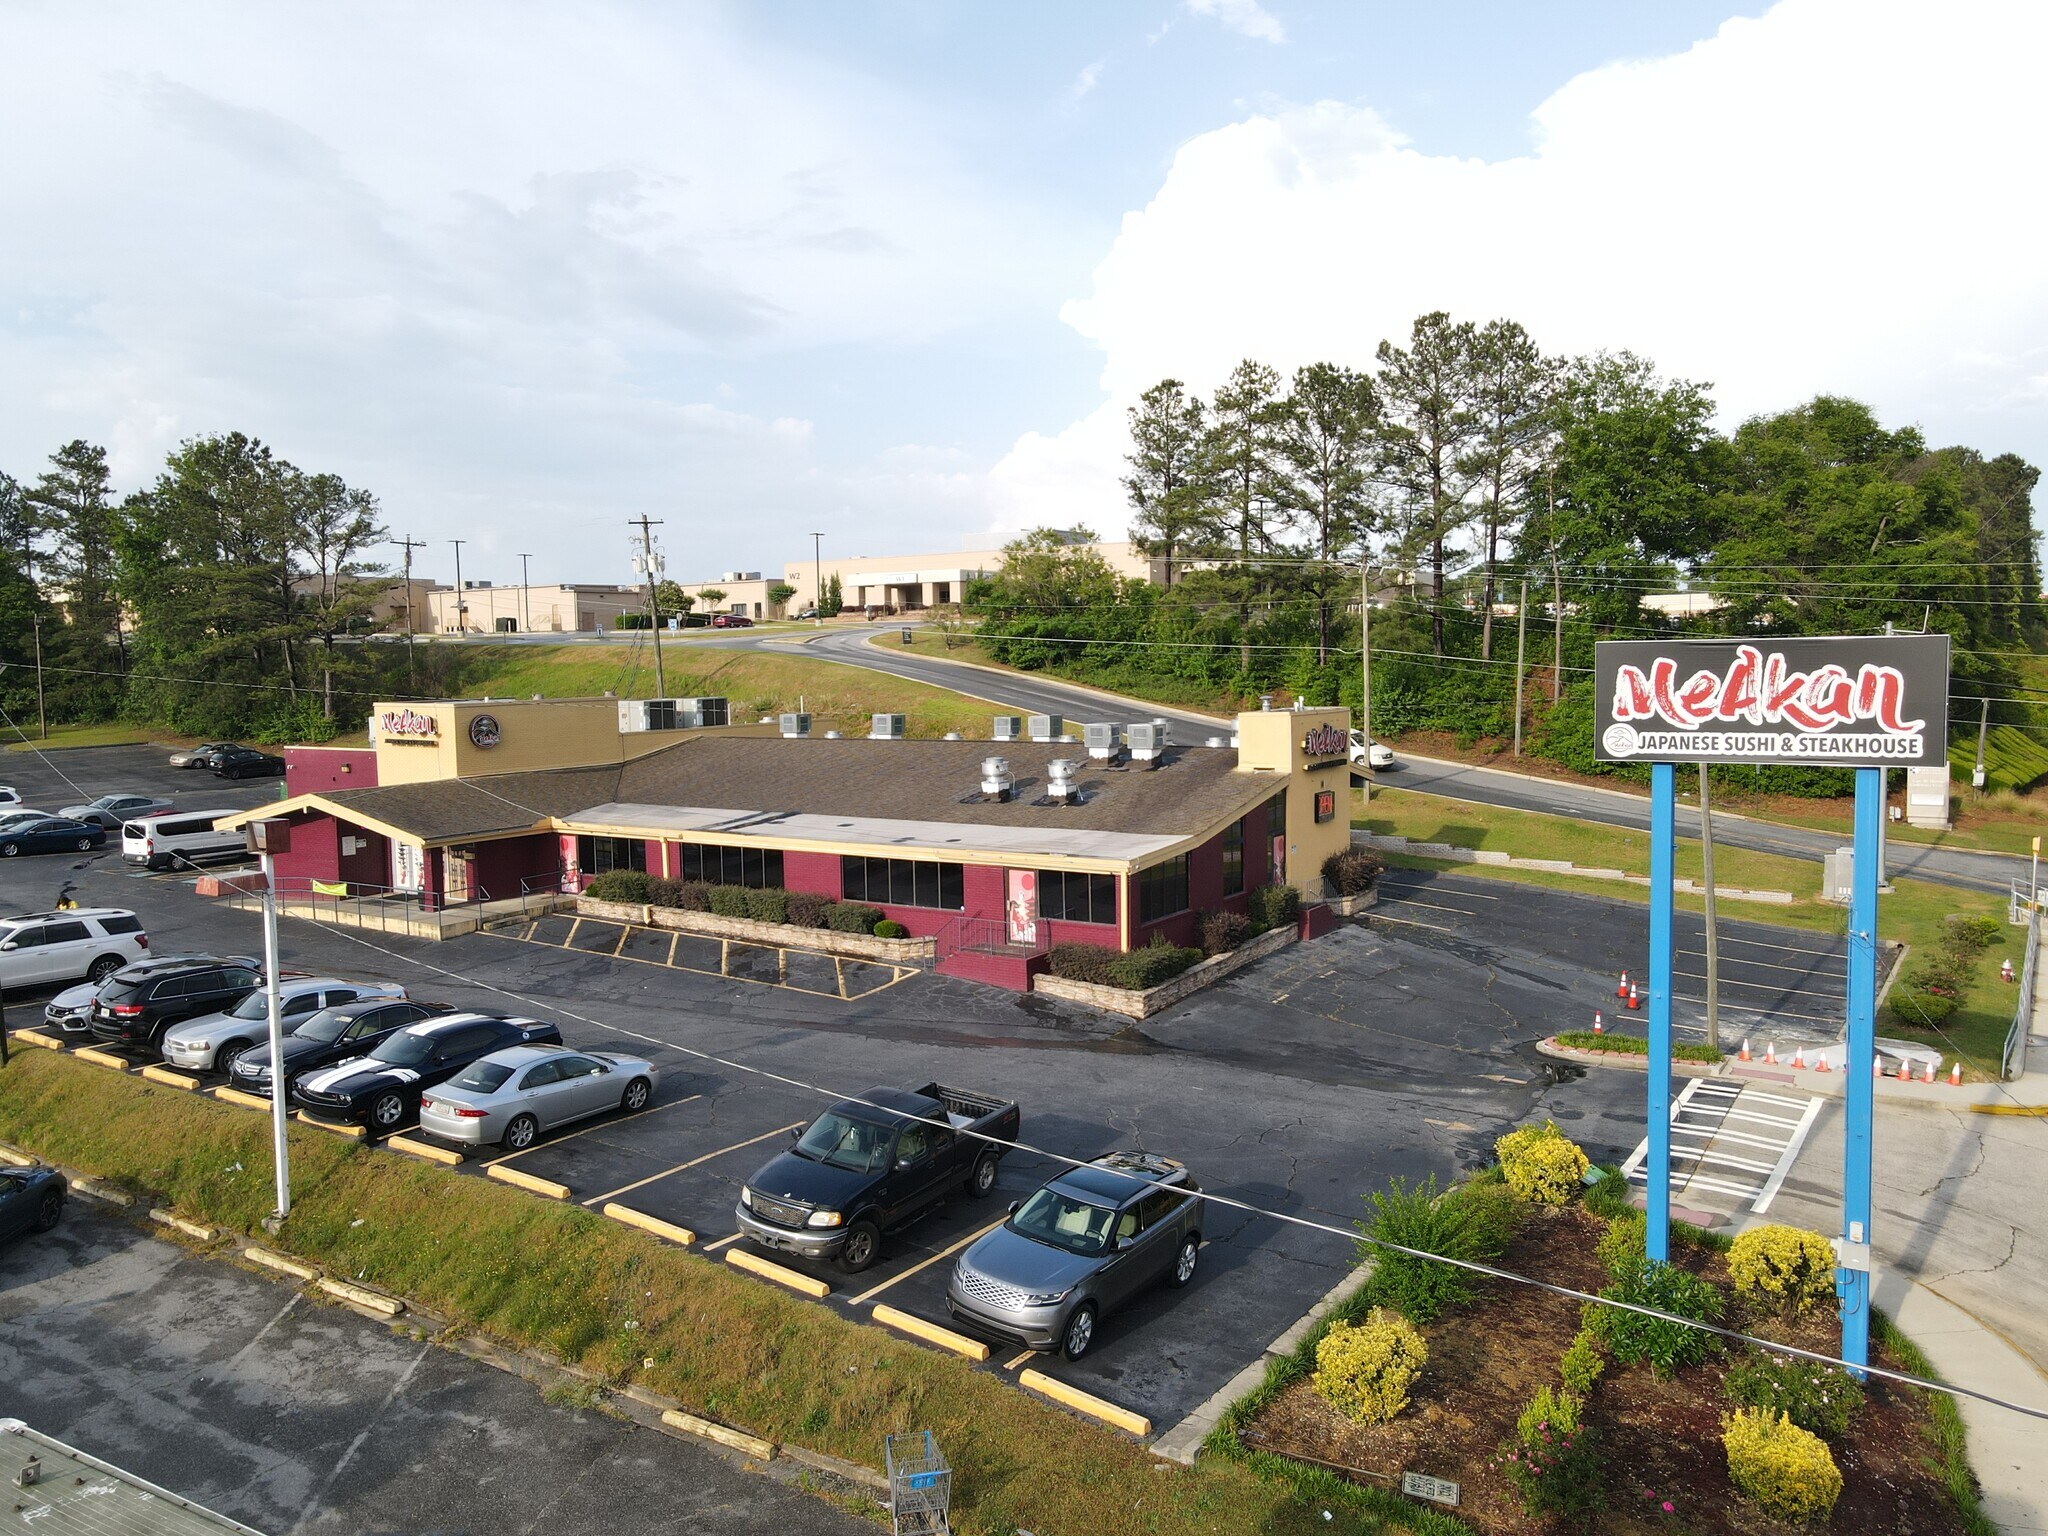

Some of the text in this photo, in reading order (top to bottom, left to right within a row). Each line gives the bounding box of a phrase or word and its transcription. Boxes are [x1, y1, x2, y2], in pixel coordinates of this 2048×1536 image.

[788, 572, 801, 580] W2
[1638, 735, 1919, 754] JAPANESE SUSHI & STEAKHOUSE
